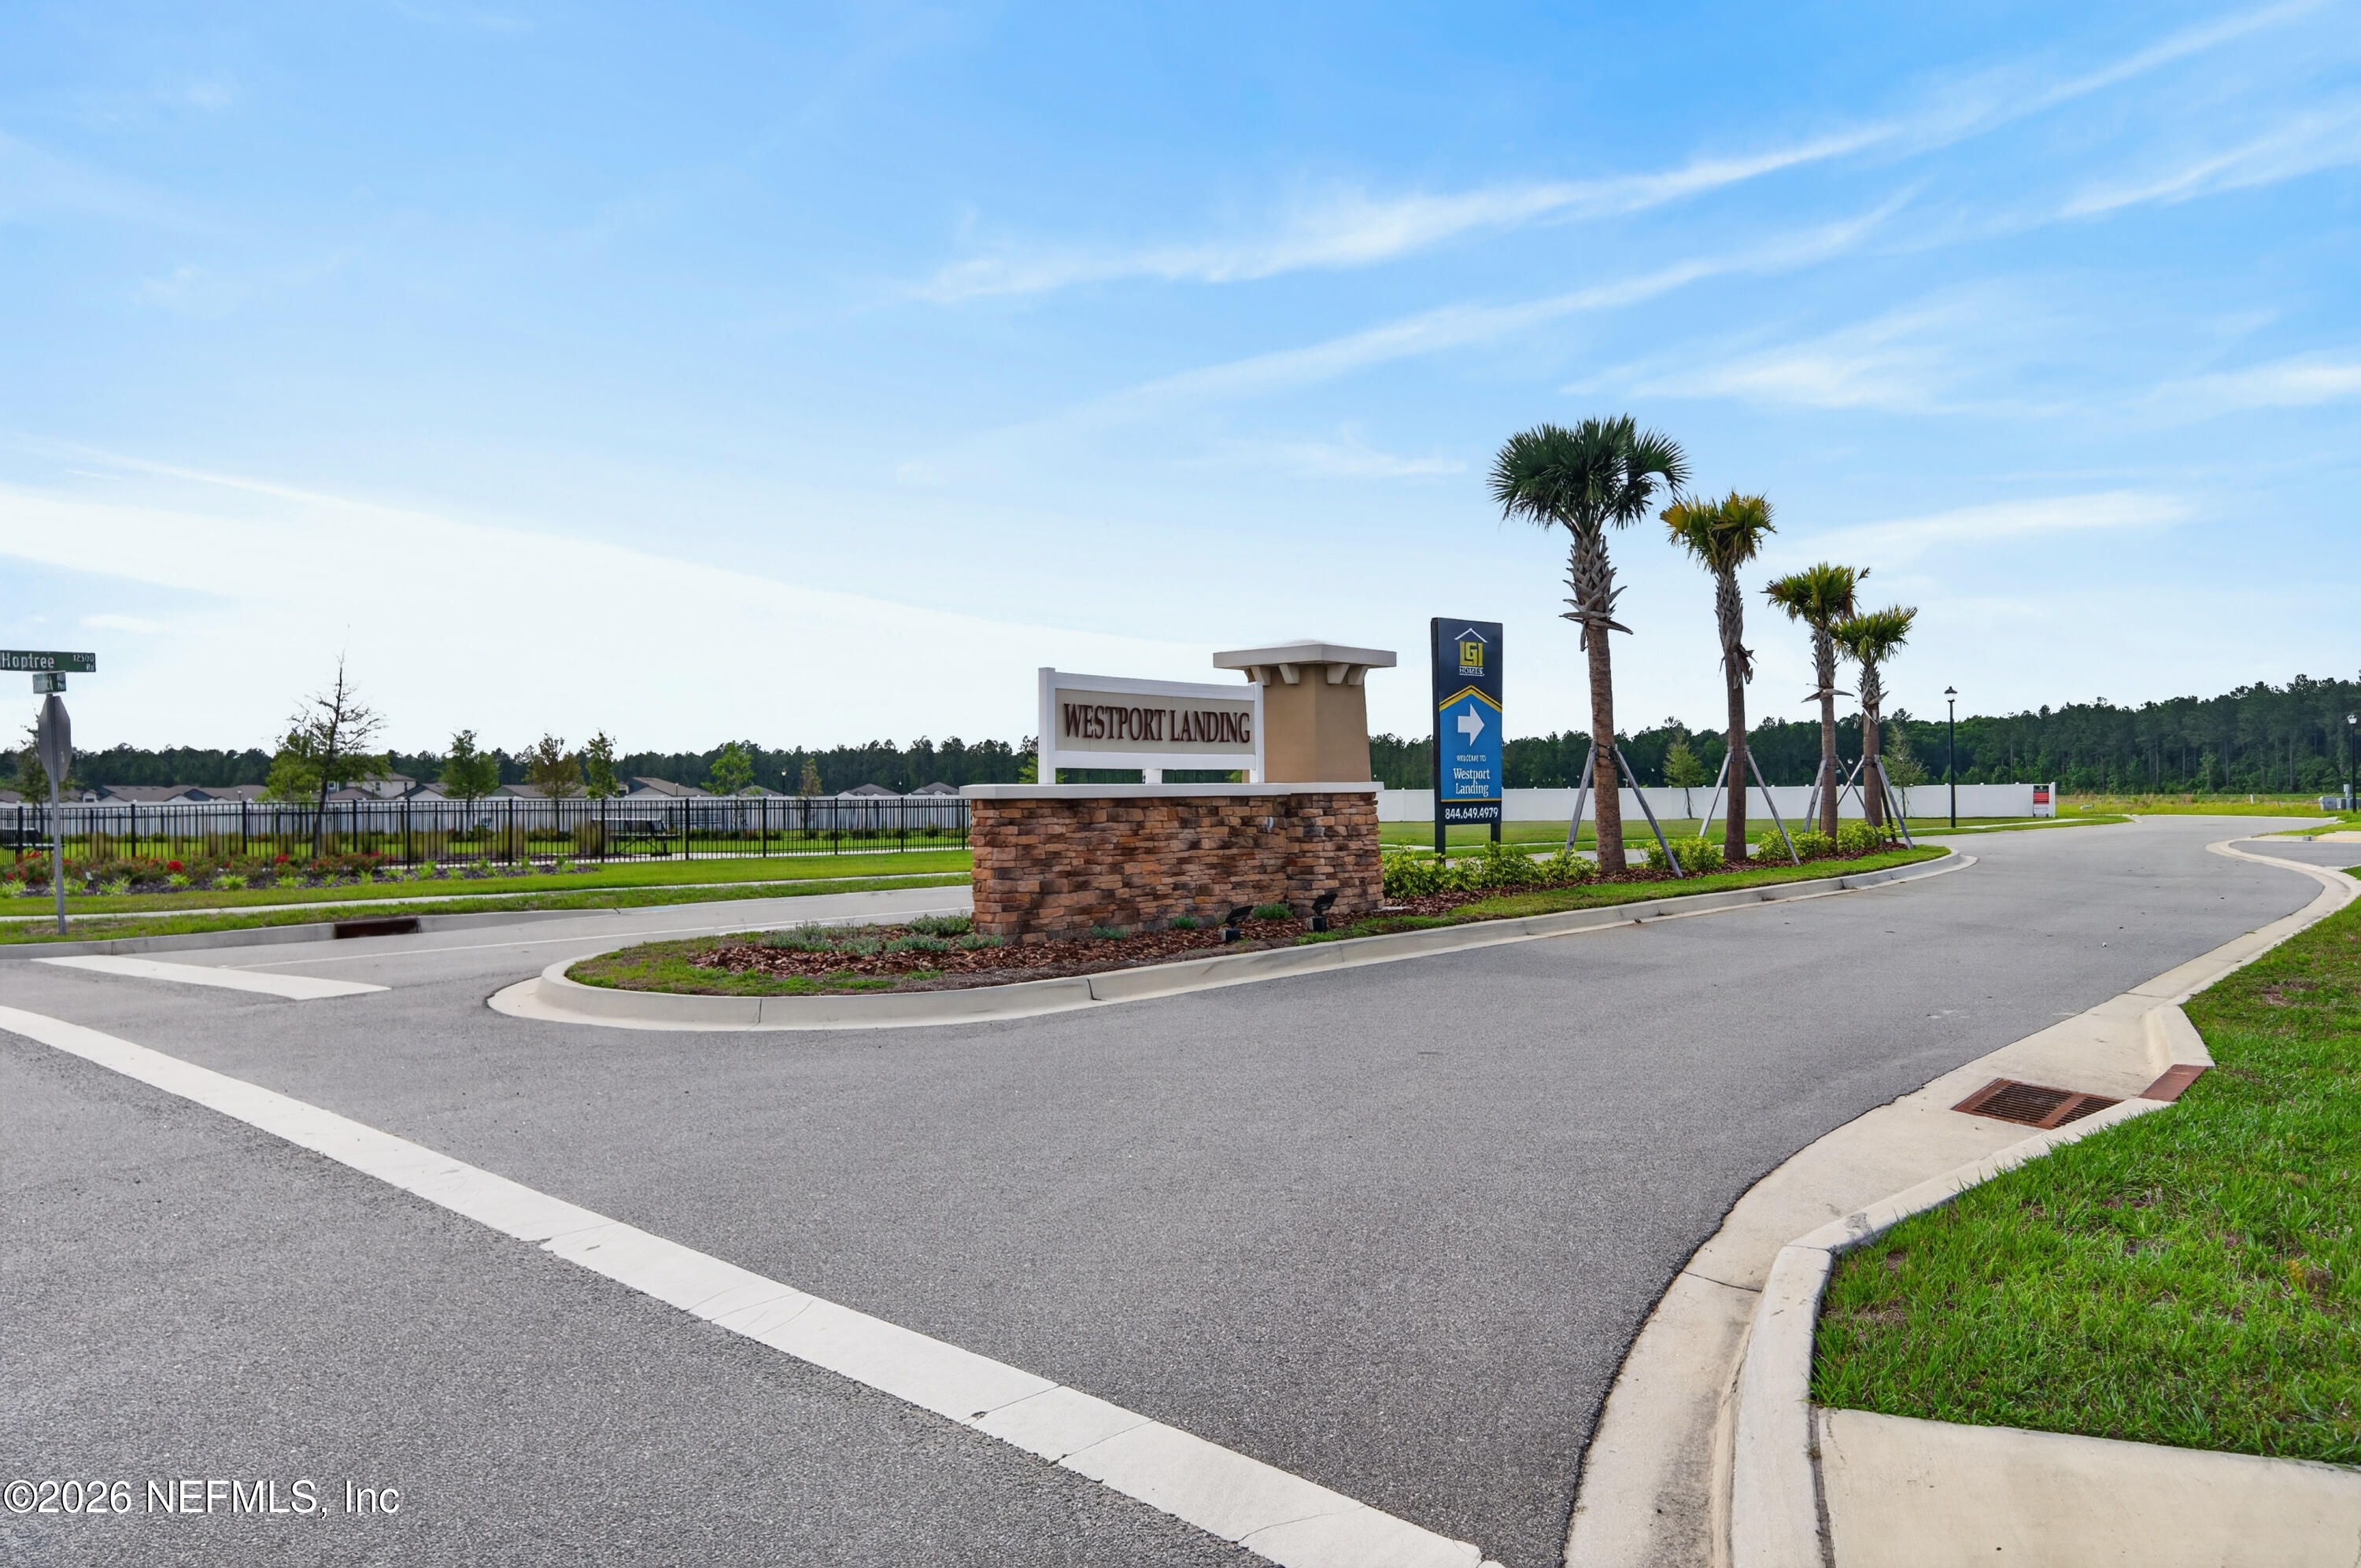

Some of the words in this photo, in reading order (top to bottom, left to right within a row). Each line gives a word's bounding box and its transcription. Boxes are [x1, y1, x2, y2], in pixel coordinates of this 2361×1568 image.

[2, 651, 55, 670] Hoptree
[1459, 640, 1483, 666] LGI
[1063, 703, 1166, 741] WESTPORT
[1169, 710, 1251, 743] LANDING
[1453, 768, 1491, 780] Westport
[1455, 781, 1489, 797] Landing
[1445, 807, 1498, 820] 844.649.4979
